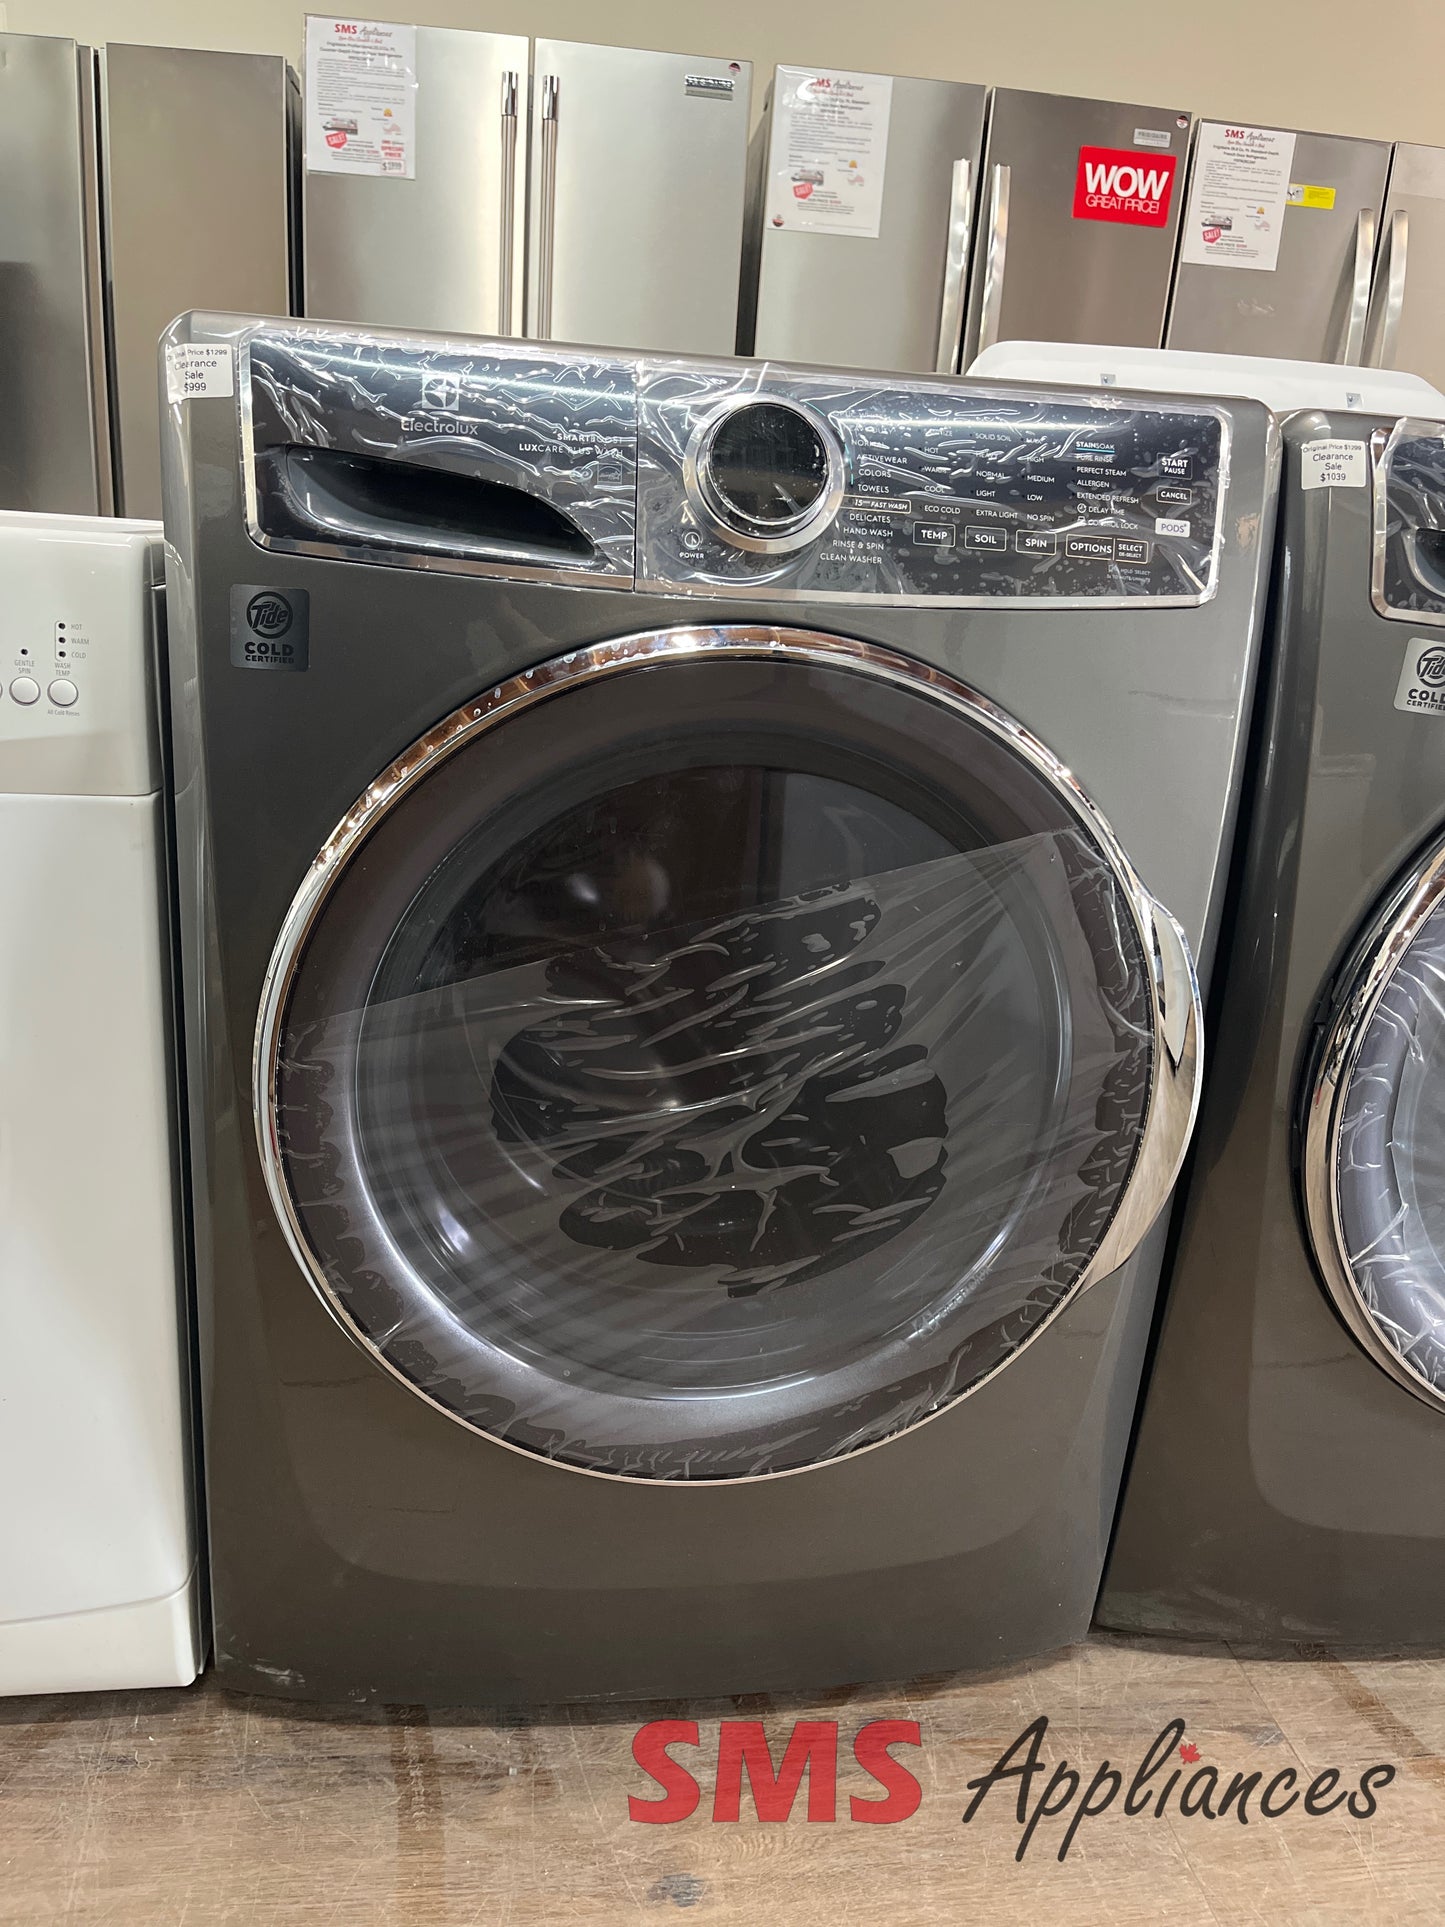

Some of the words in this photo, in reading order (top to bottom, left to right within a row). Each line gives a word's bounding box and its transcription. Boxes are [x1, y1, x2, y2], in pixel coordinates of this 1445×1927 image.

[335, 24, 357, 34] SMS
[1225, 129, 1245, 139] SMS
[1085, 162, 1169, 201] WOW
[1085, 194, 1124, 210] GREAT
[1124, 199, 1160, 214] PRICE!
[206, 348, 228, 356] $1299
[185, 370, 204, 380] Sale
[184, 382, 207, 392] $999
[401, 418, 479, 436] Electrolux
[975, 433, 996, 441] SOLID
[997, 434, 1012, 442] SOIL
[519, 443, 564, 454] LUXCARE
[1075, 441, 1115, 450] STAINSOAK
[1303, 444, 1327, 453] Original
[856, 454, 907, 464] ACTIVEWEAR
[1076, 454, 1094, 462] PURE
[1094, 455, 1113, 463] RINSE
[1312, 453, 1353, 461] Clearance
[1161, 457, 1188, 468] START
[1325, 462, 1342, 471] Sale
[858, 468, 892, 478] COLORS
[976, 470, 1006, 479] NORMAL
[1076, 466, 1104, 475] PERFECT
[1105, 468, 1127, 476] STEAM
[1164, 467, 1185, 475] PAUSE
[1027, 475, 1055, 483] MEDIUM
[1320, 472, 1346, 482] $1039
[858, 484, 889, 493] TOWELS
[1076, 479, 1110, 488] ALLERGEN
[924, 485, 945, 493] COOL
[1076, 492, 1111, 501] EXTENDED
[1111, 495, 1139, 504] REFRESH
[1160, 491, 1188, 500] CANCEL
[870, 501, 887, 509] FAST
[924, 504, 940, 512] ECO
[941, 506, 961, 514] COLD
[998, 511, 1019, 519] LIGHT
[1088, 506, 1109, 514] DELAY
[1110, 507, 1125, 516] TIME
[849, 513, 891, 524] DELICATES
[1120, 522, 1139, 530] LOCK
[843, 527, 867, 535] HAND
[869, 528, 893, 537] WASH
[921, 529, 948, 540] TEMP
[974, 534, 997, 544] SOIL
[1025, 538, 1047, 548] SPIN
[832, 540, 855, 549] RINSE
[857, 541, 864, 549] &
[866, 542, 884, 550] SPIN
[1070, 542, 1112, 554] OPTIONS
[1118, 544, 1143, 552] SELECT
[679, 551, 705, 559] POWER
[820, 552, 847, 561] CLEAN
[848, 554, 882, 564] WASHER
[251, 601, 289, 629] Tide
[244, 641, 294, 657] COLD
[14, 659, 35, 667] GENTLE
[245, 654, 295, 664] CERTIFIED
[1419, 655, 1445, 678] Tid
